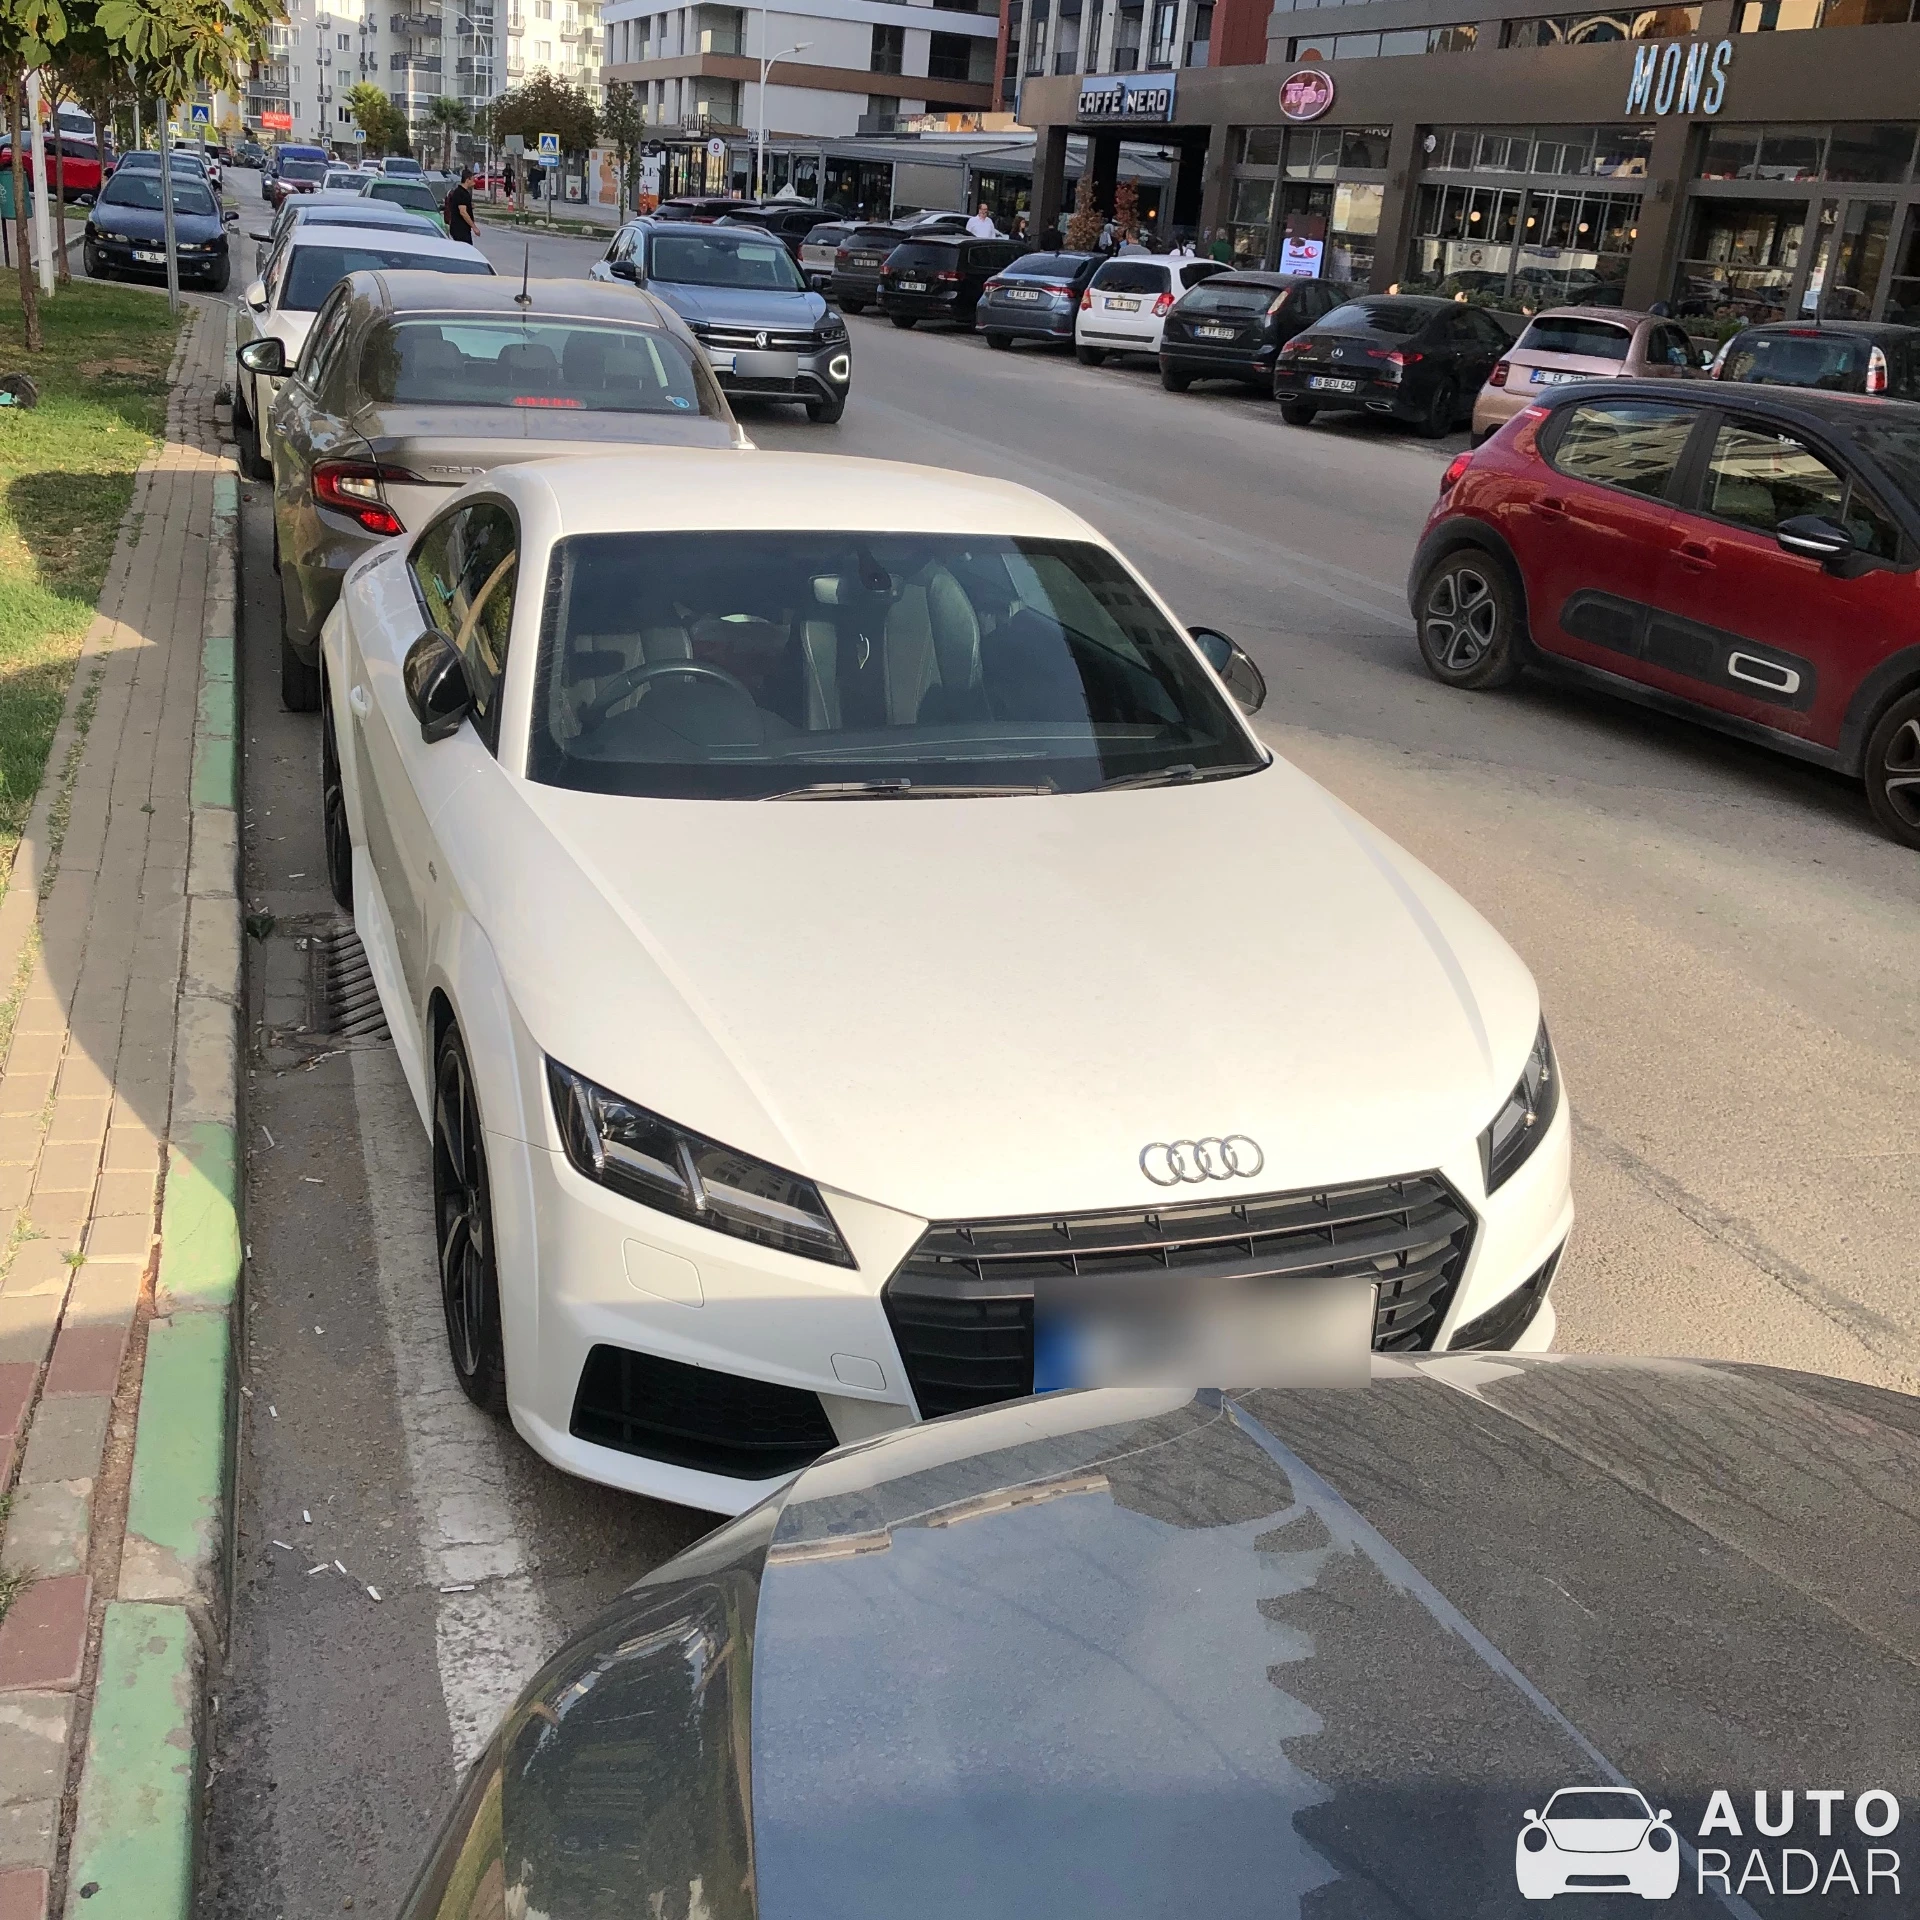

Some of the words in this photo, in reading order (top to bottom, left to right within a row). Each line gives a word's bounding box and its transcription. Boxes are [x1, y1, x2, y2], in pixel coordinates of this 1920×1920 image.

[1625, 40, 1732, 115] MONS
[1126, 89, 1168, 113] NERO
[1314, 378, 1322, 386] 16
[1324, 379, 1340, 388] BEU
[1340, 380, 1355, 390] 646
